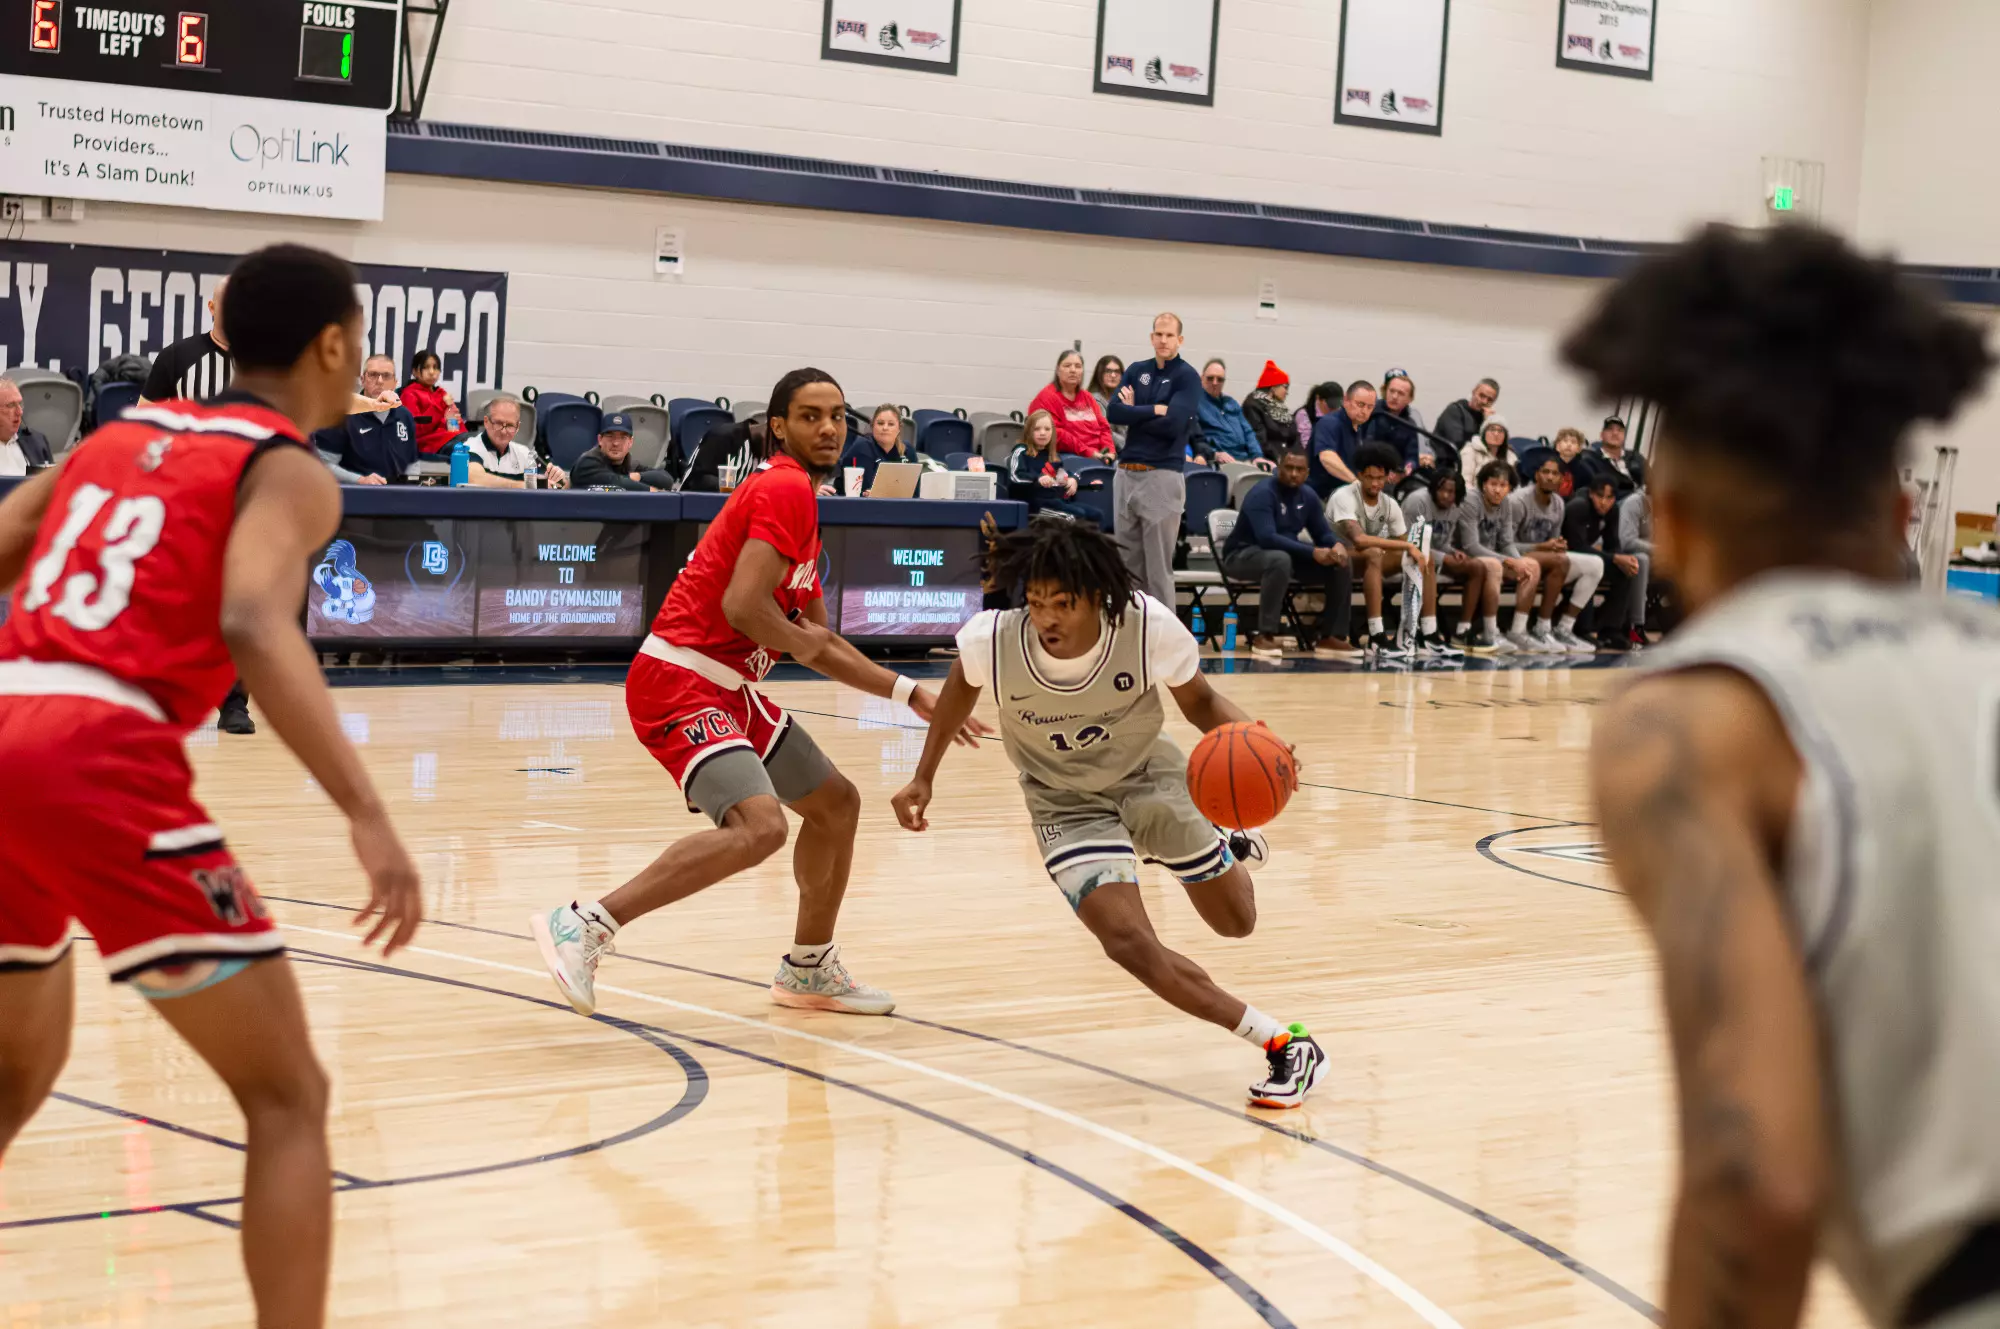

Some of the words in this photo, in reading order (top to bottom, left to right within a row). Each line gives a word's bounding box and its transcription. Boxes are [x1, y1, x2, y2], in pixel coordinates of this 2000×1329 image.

[33, 1, 57, 49] 6
[75, 6, 166, 37] TIMEOUTS
[302, 3, 355, 28] FOULS
[99, 32, 143, 58] LEFT
[180, 16, 203, 64] 6
[341, 33, 351, 79] 1
[38, 101, 104, 123] Trusted
[111, 108, 204, 132] Hometown
[73, 133, 169, 157] Providers...
[230, 124, 350, 169] OptiLink
[44, 159, 70, 176] It's
[76, 162, 90, 178] A
[96, 163, 139, 182] Slam
[145, 167, 195, 186] Dunk!
[248, 180, 333, 198] OPTILINK.US
[23, 483, 166, 631] 13
[538, 544, 597, 562] WELCOME
[892, 549, 944, 566] WELCOME
[558, 567, 575, 584] TO
[910, 571, 925, 586] TO
[505, 589, 548, 607] BANDY
[550, 589, 622, 607] GYMNASIUM
[864, 591, 902, 607] BANDY
[903, 591, 966, 608] GYMNASIUM
[509, 612, 531, 623] HOME
[533, 612, 542, 623] OF
[544, 612, 559, 623] THE
[560, 612, 616, 623] ROADRUNNERS
[867, 612, 886, 623] HOME
[888, 613, 897, 623] OF
[898, 612, 911, 623] THE
[912, 612, 961, 623] ROADRUNNERS
